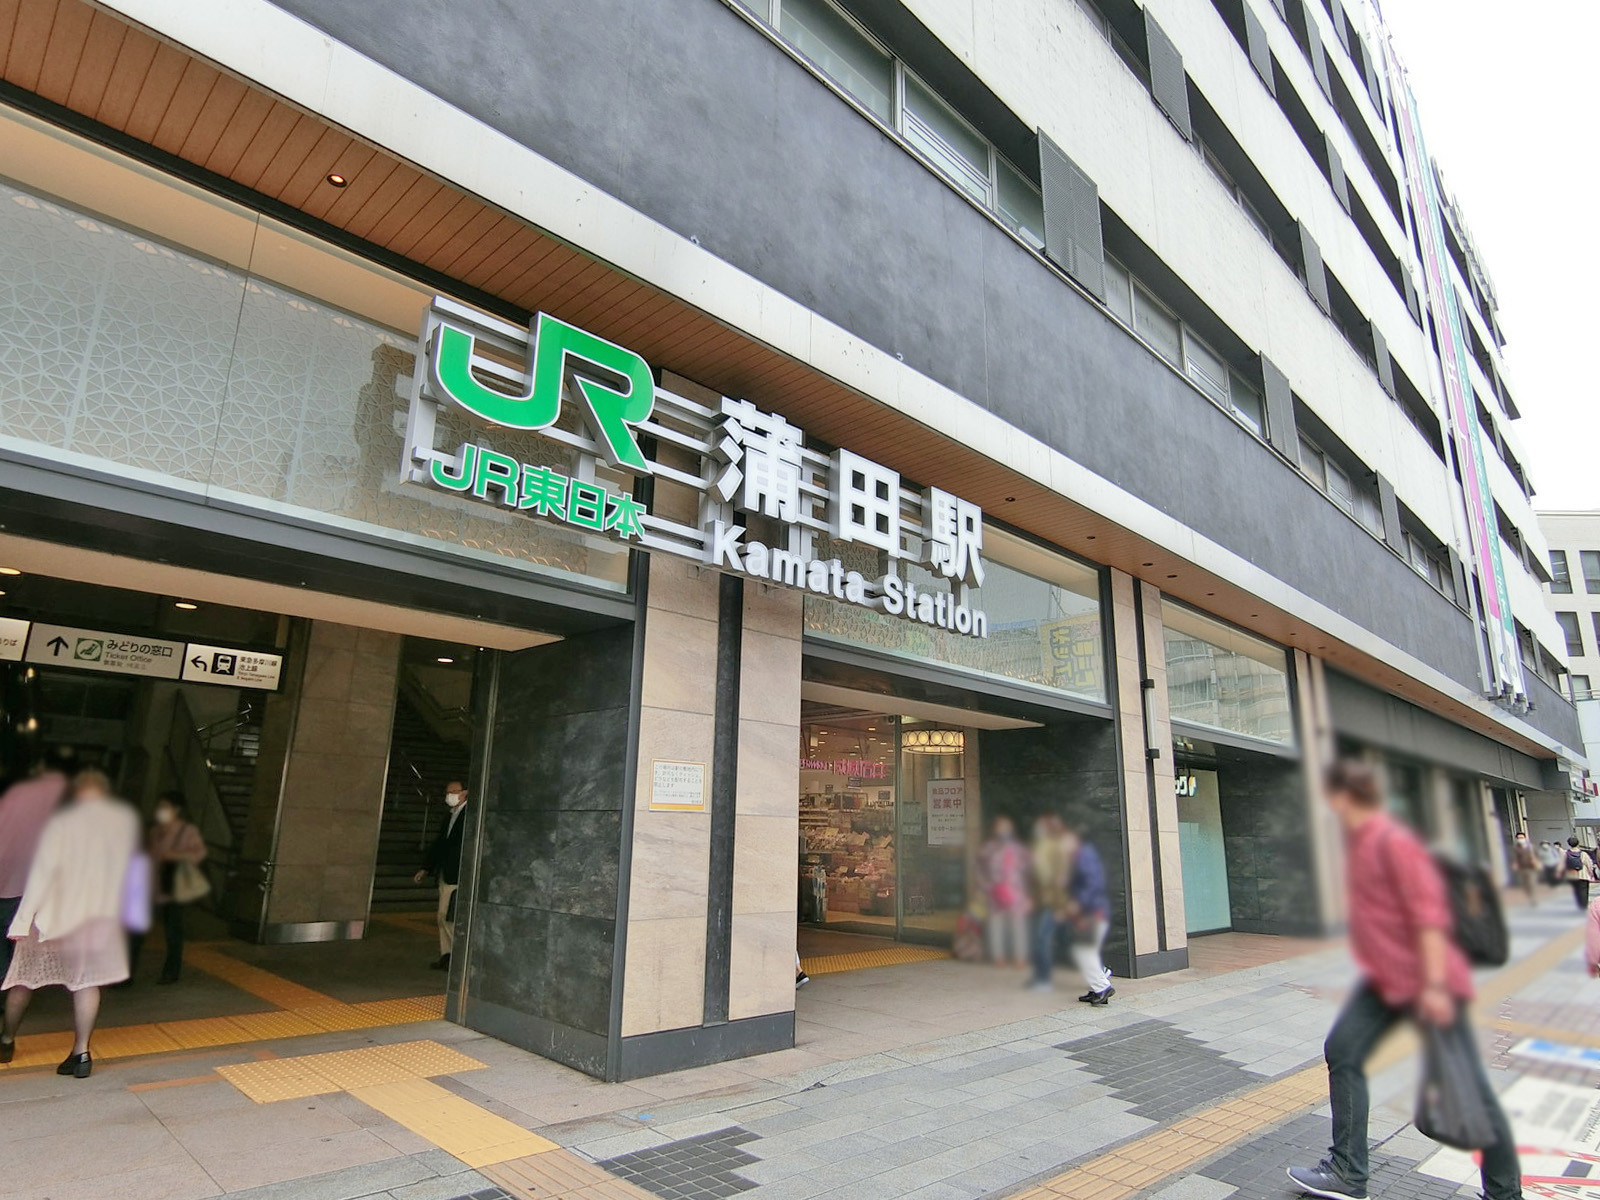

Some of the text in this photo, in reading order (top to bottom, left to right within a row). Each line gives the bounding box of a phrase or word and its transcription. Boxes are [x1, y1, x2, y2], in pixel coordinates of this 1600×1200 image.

[432, 311, 656, 474] JR
[428, 442, 647, 540] JR東日本
[714, 398, 986, 588] 蒲田駅
[708, 518, 988, 638] Kamata Station
[106, 639, 173, 658] みどりの窓口
